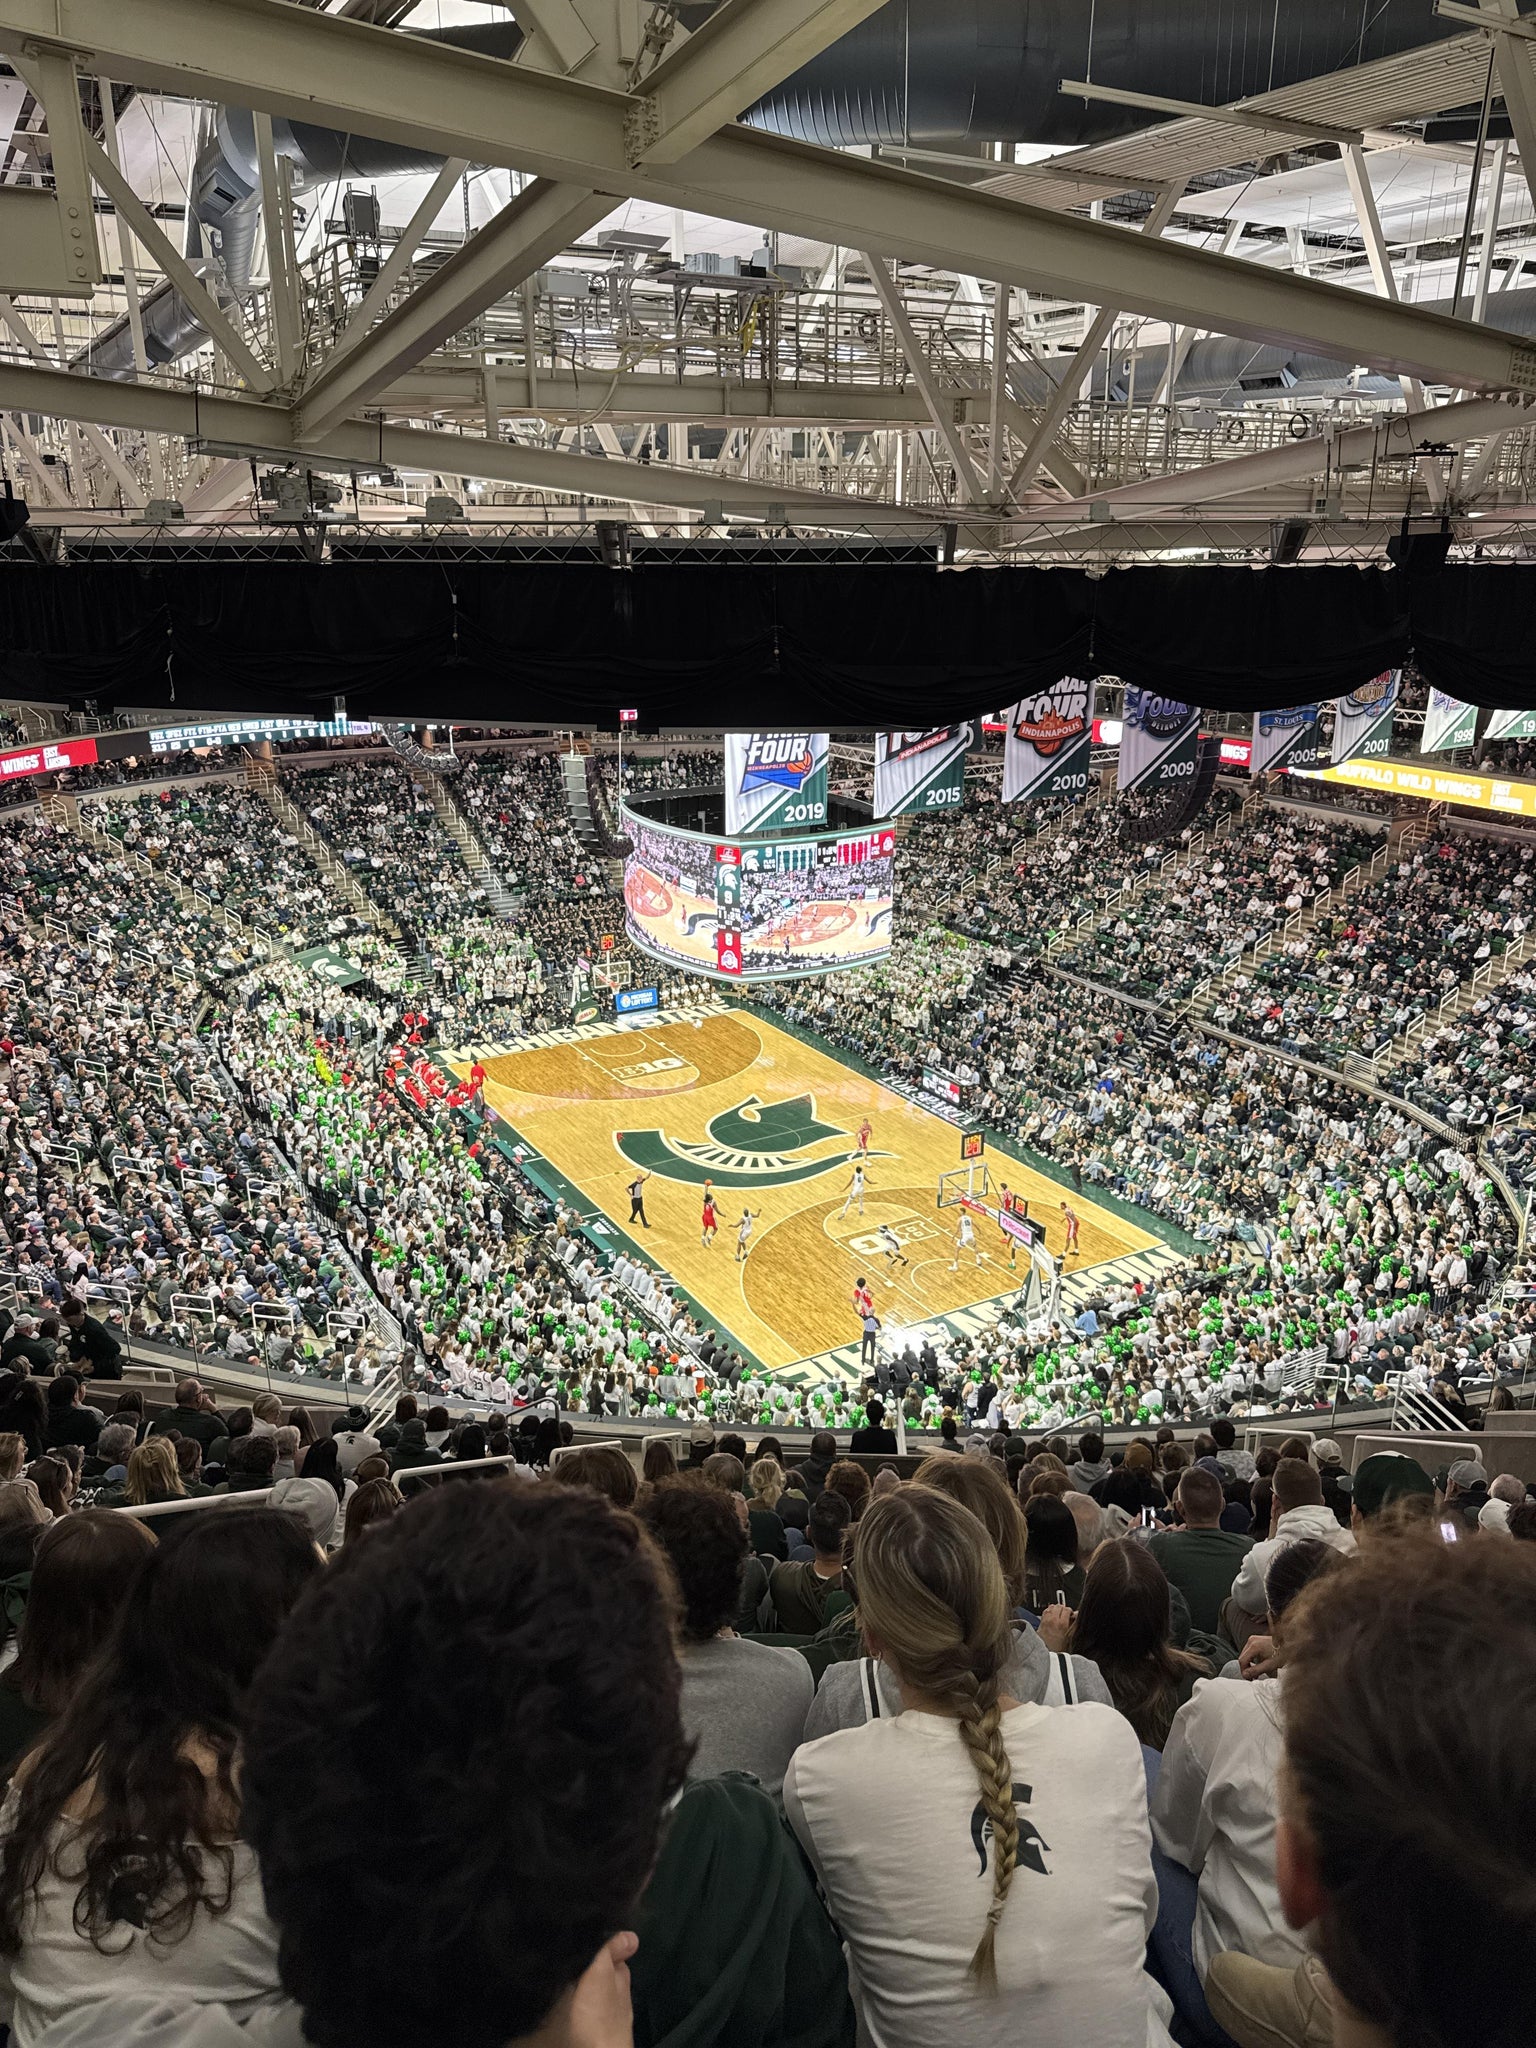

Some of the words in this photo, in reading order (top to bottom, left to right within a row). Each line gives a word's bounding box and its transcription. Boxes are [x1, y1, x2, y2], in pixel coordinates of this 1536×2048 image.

[1016, 693, 1088, 725] FOUR
[1137, 690, 1188, 719] FOUR
[1022, 721, 1080, 738] INDIANAPOLIS
[1284, 714, 1303, 726] LOUIS
[900, 732, 948, 759] INDIANAPOLIS
[1453, 728, 1474, 744] 1999
[748, 738, 807, 765] FOUR
[1221, 743, 1249, 760] INGS
[1363, 738, 1389, 754] 2001
[1, 754, 40, 775] WINGS
[1287, 748, 1317, 765] 2005
[747, 763, 785, 771] MINNEAPOLIS
[1160, 761, 1194, 779] 2009
[1051, 773, 1086, 791] 2010
[1337, 763, 1392, 784] BUFFALO
[1397, 771, 1431, 791] WILD
[1435, 778, 1482, 799] WINGS
[926, 787, 960, 806] 2015
[784, 802, 825, 822] 2019
[436, 1020, 636, 1065] MICHIGAN
[630, 1000, 731, 1030] STATE
[849, 1220, 941, 1256] BG
